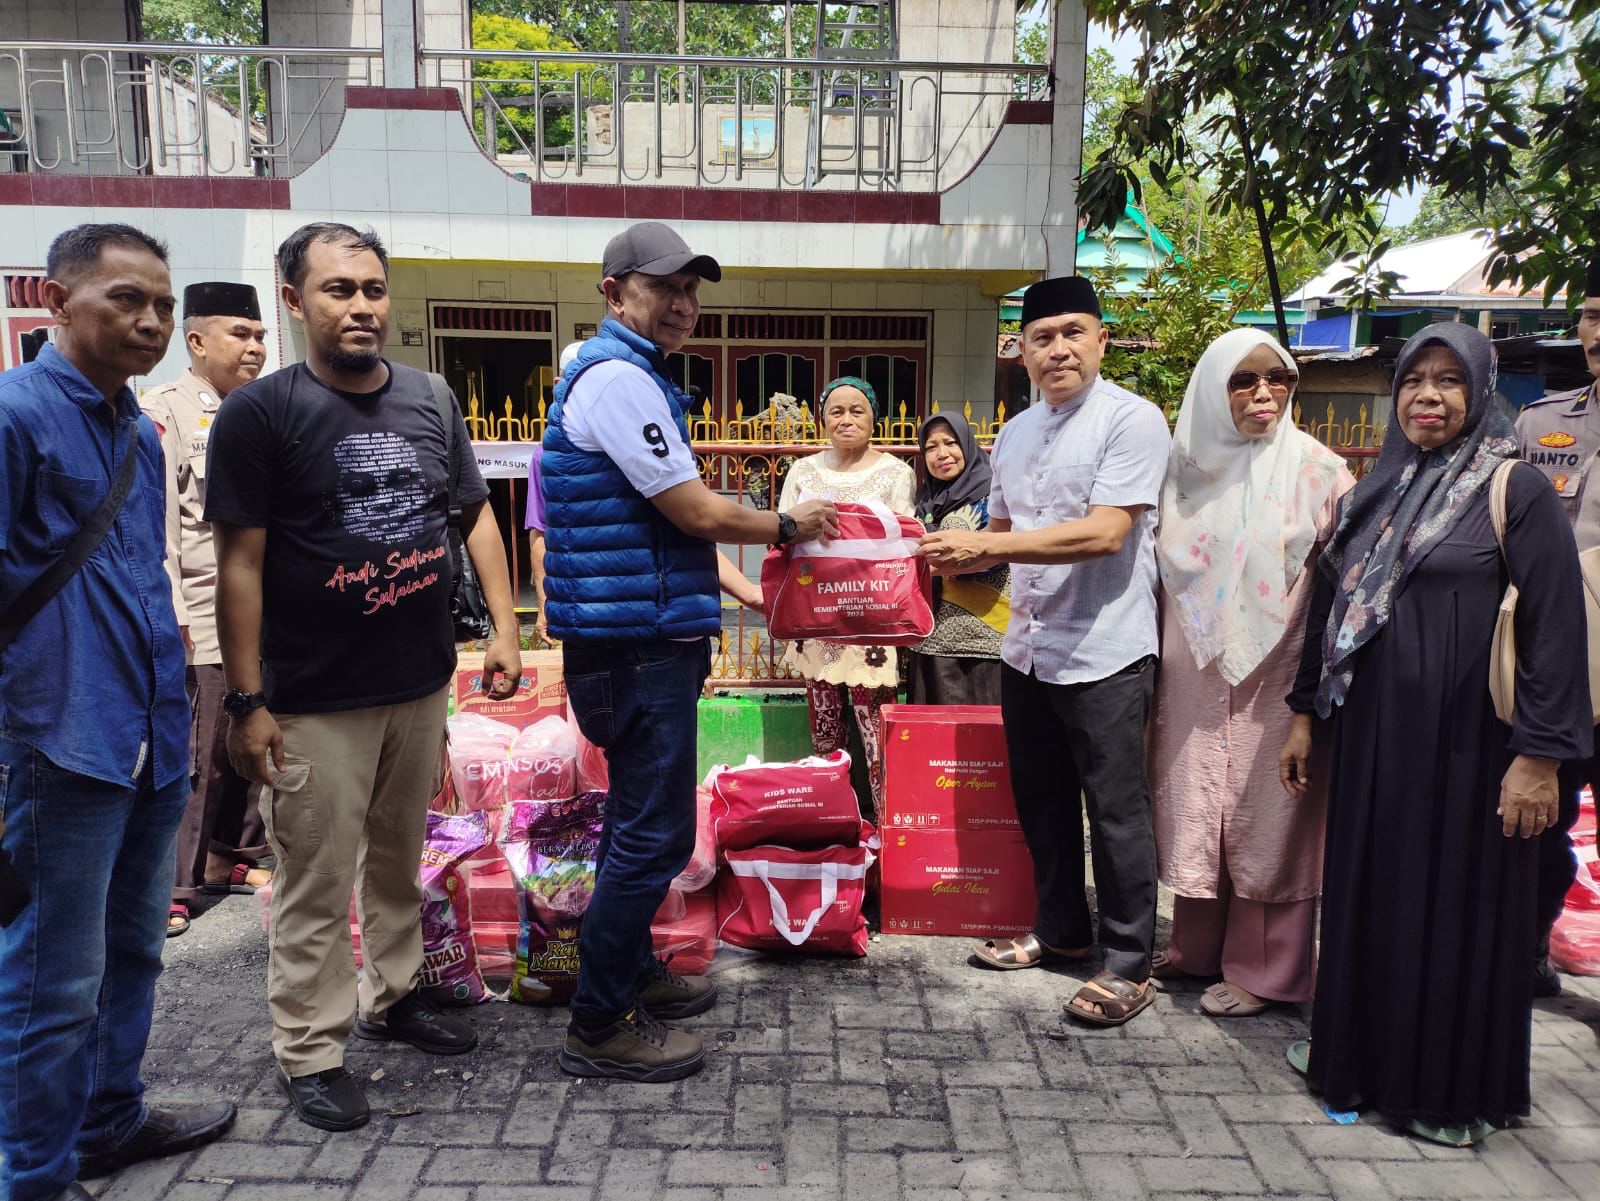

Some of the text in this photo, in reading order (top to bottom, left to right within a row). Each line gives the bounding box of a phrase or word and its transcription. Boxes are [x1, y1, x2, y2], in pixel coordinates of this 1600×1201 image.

[642, 422, 670, 458] 9
[494, 460, 528, 468] MASUK
[325, 561, 379, 592] Andi
[817, 580, 890, 594] FAMILY KIT
[814, 604, 864, 613] KEMENTERIAN
[491, 705, 516, 713] Instan
[964, 776, 997, 790] Ayam
[764, 786, 814, 798] KIDS WARE
[932, 880, 990, 896] Gulai Ikan
